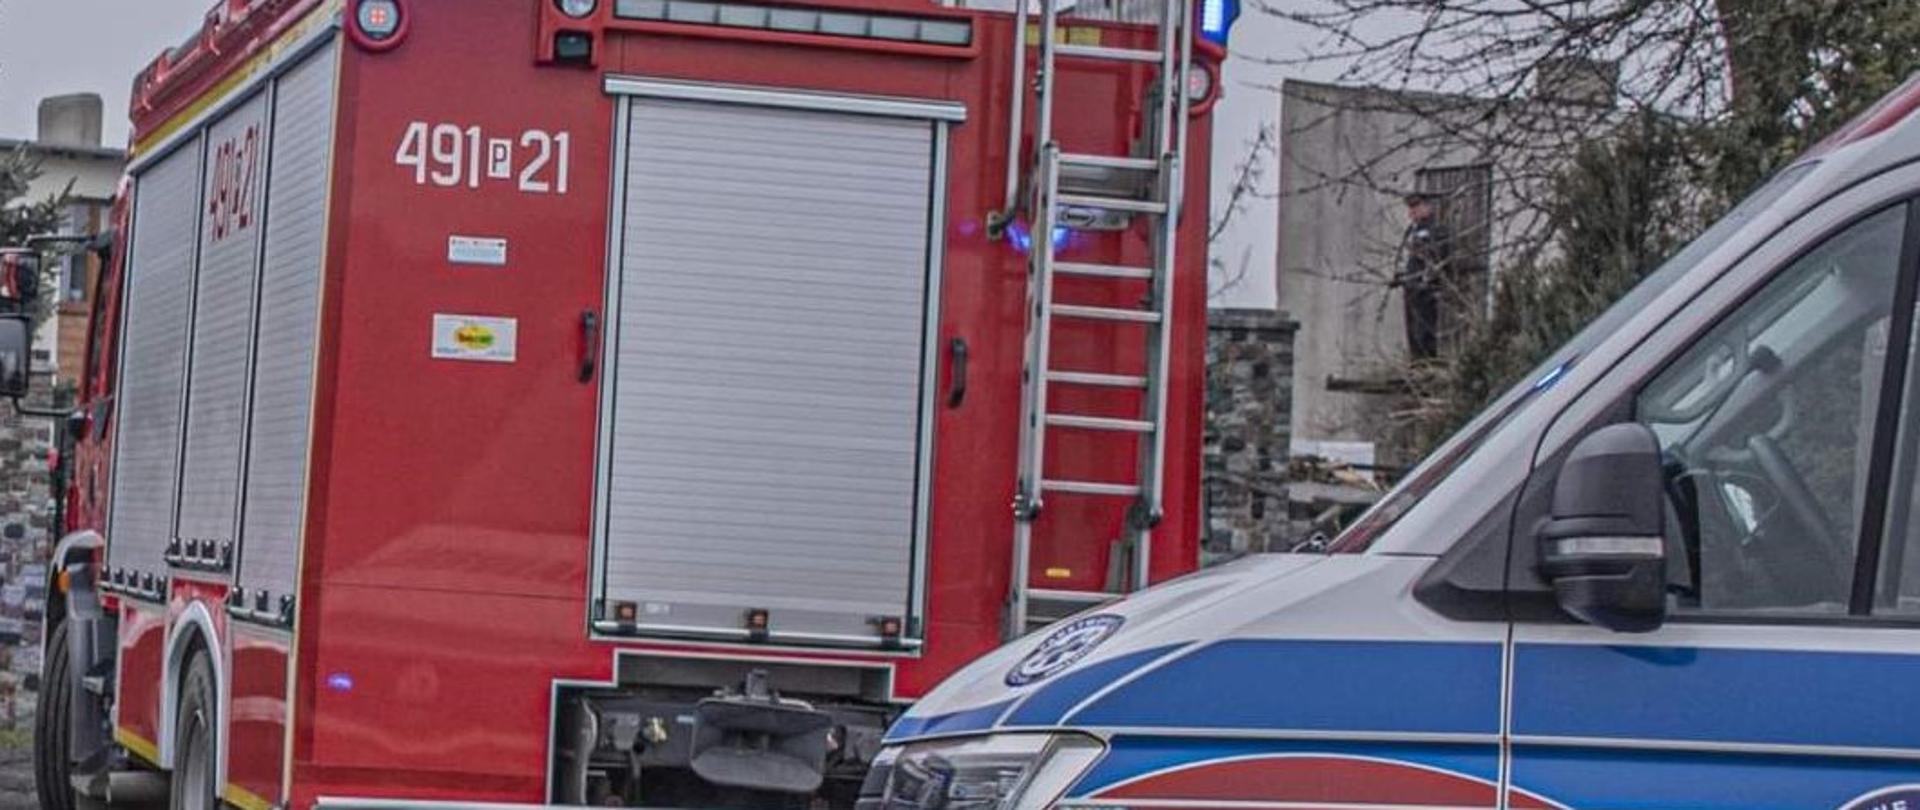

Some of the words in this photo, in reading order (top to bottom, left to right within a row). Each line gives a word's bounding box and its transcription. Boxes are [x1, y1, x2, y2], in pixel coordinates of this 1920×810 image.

[395, 121, 481, 188] 491
[491, 142, 508, 174] P
[519, 129, 569, 193] 21
